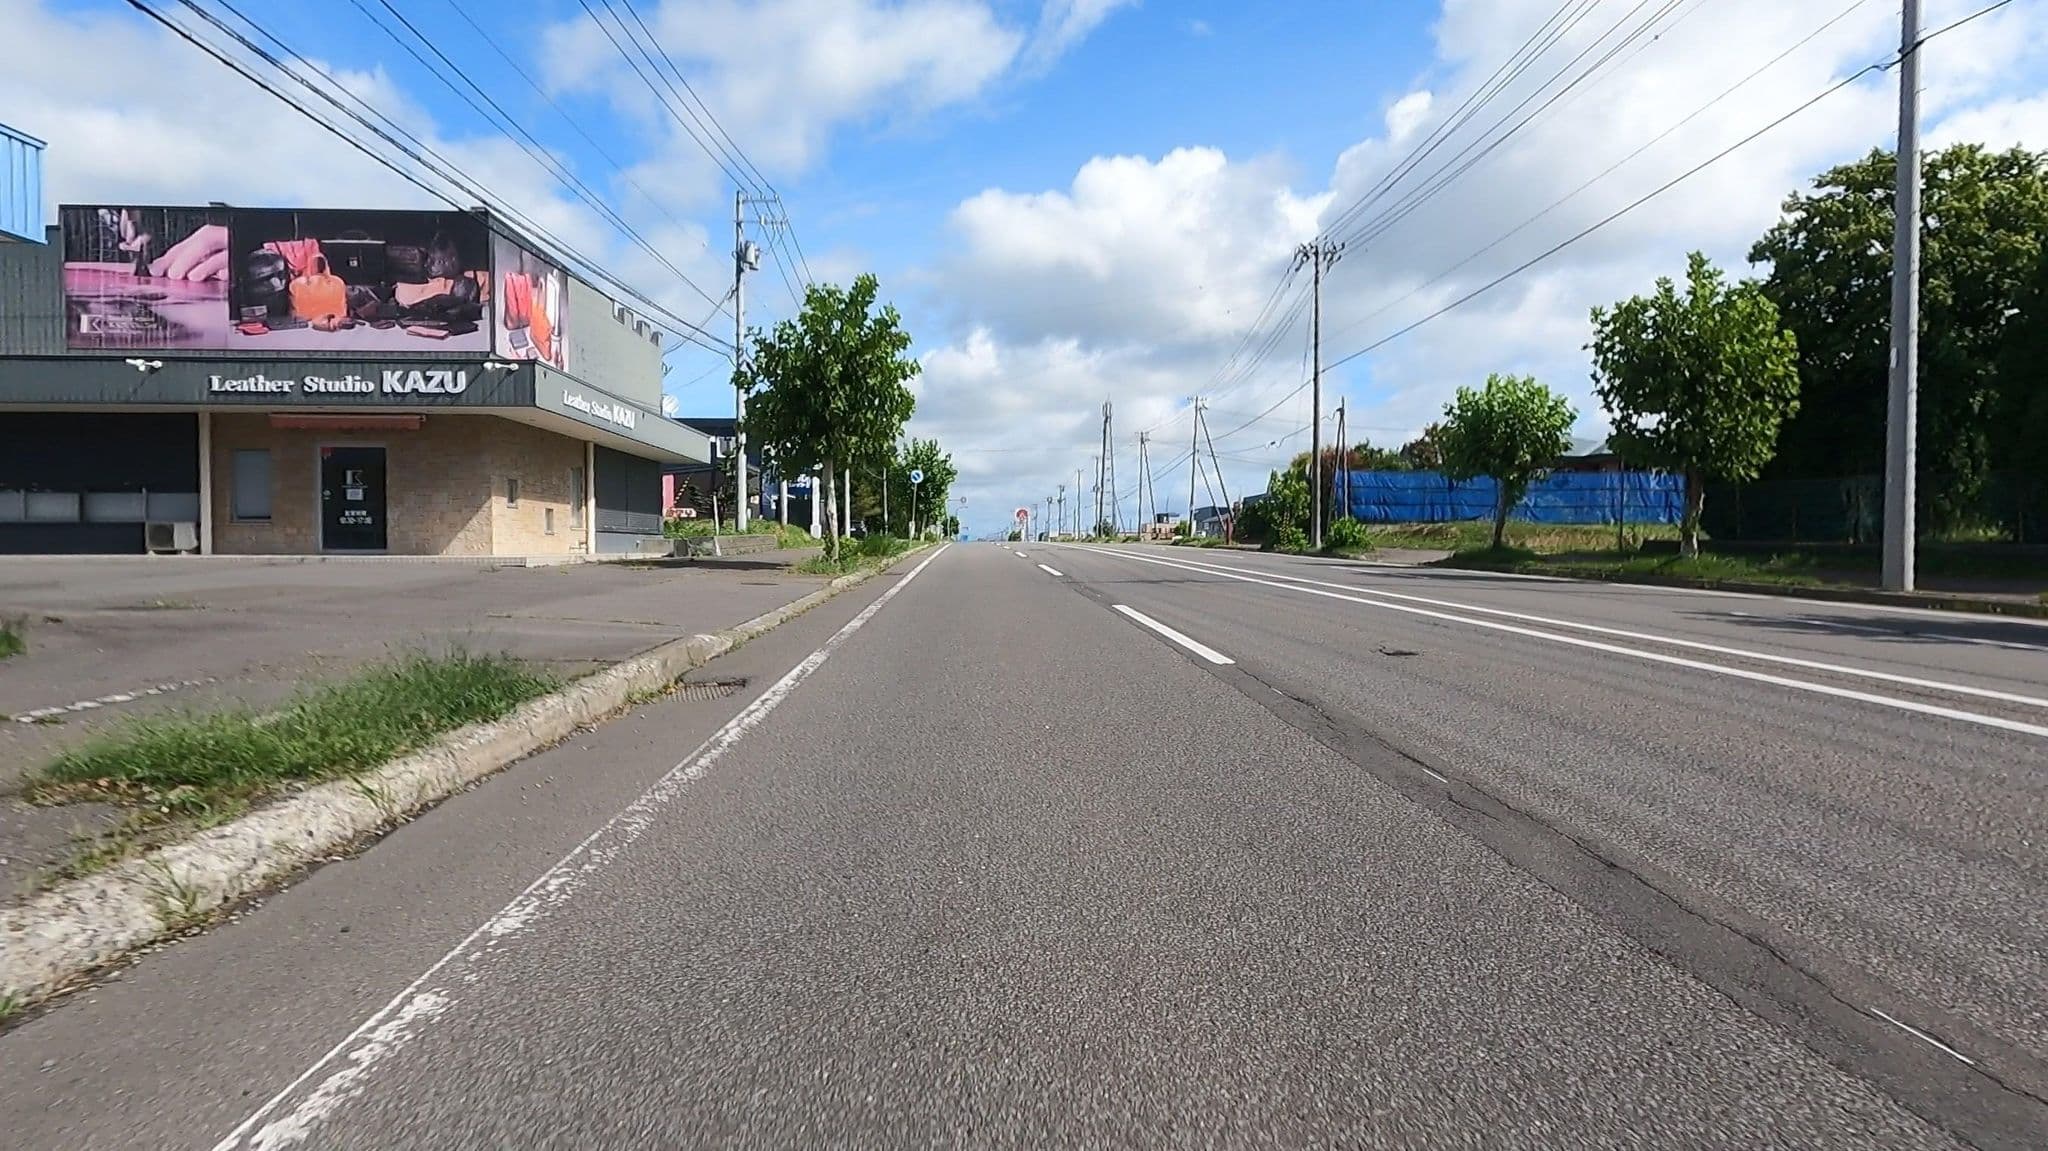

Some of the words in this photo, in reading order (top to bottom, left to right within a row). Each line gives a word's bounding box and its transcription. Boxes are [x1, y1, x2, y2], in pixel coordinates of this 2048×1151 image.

[209, 374, 295, 393] Leather
[303, 375, 375, 393] Studio
[382, 370, 467, 394] KAZU
[613, 403, 635, 431] KAZU
